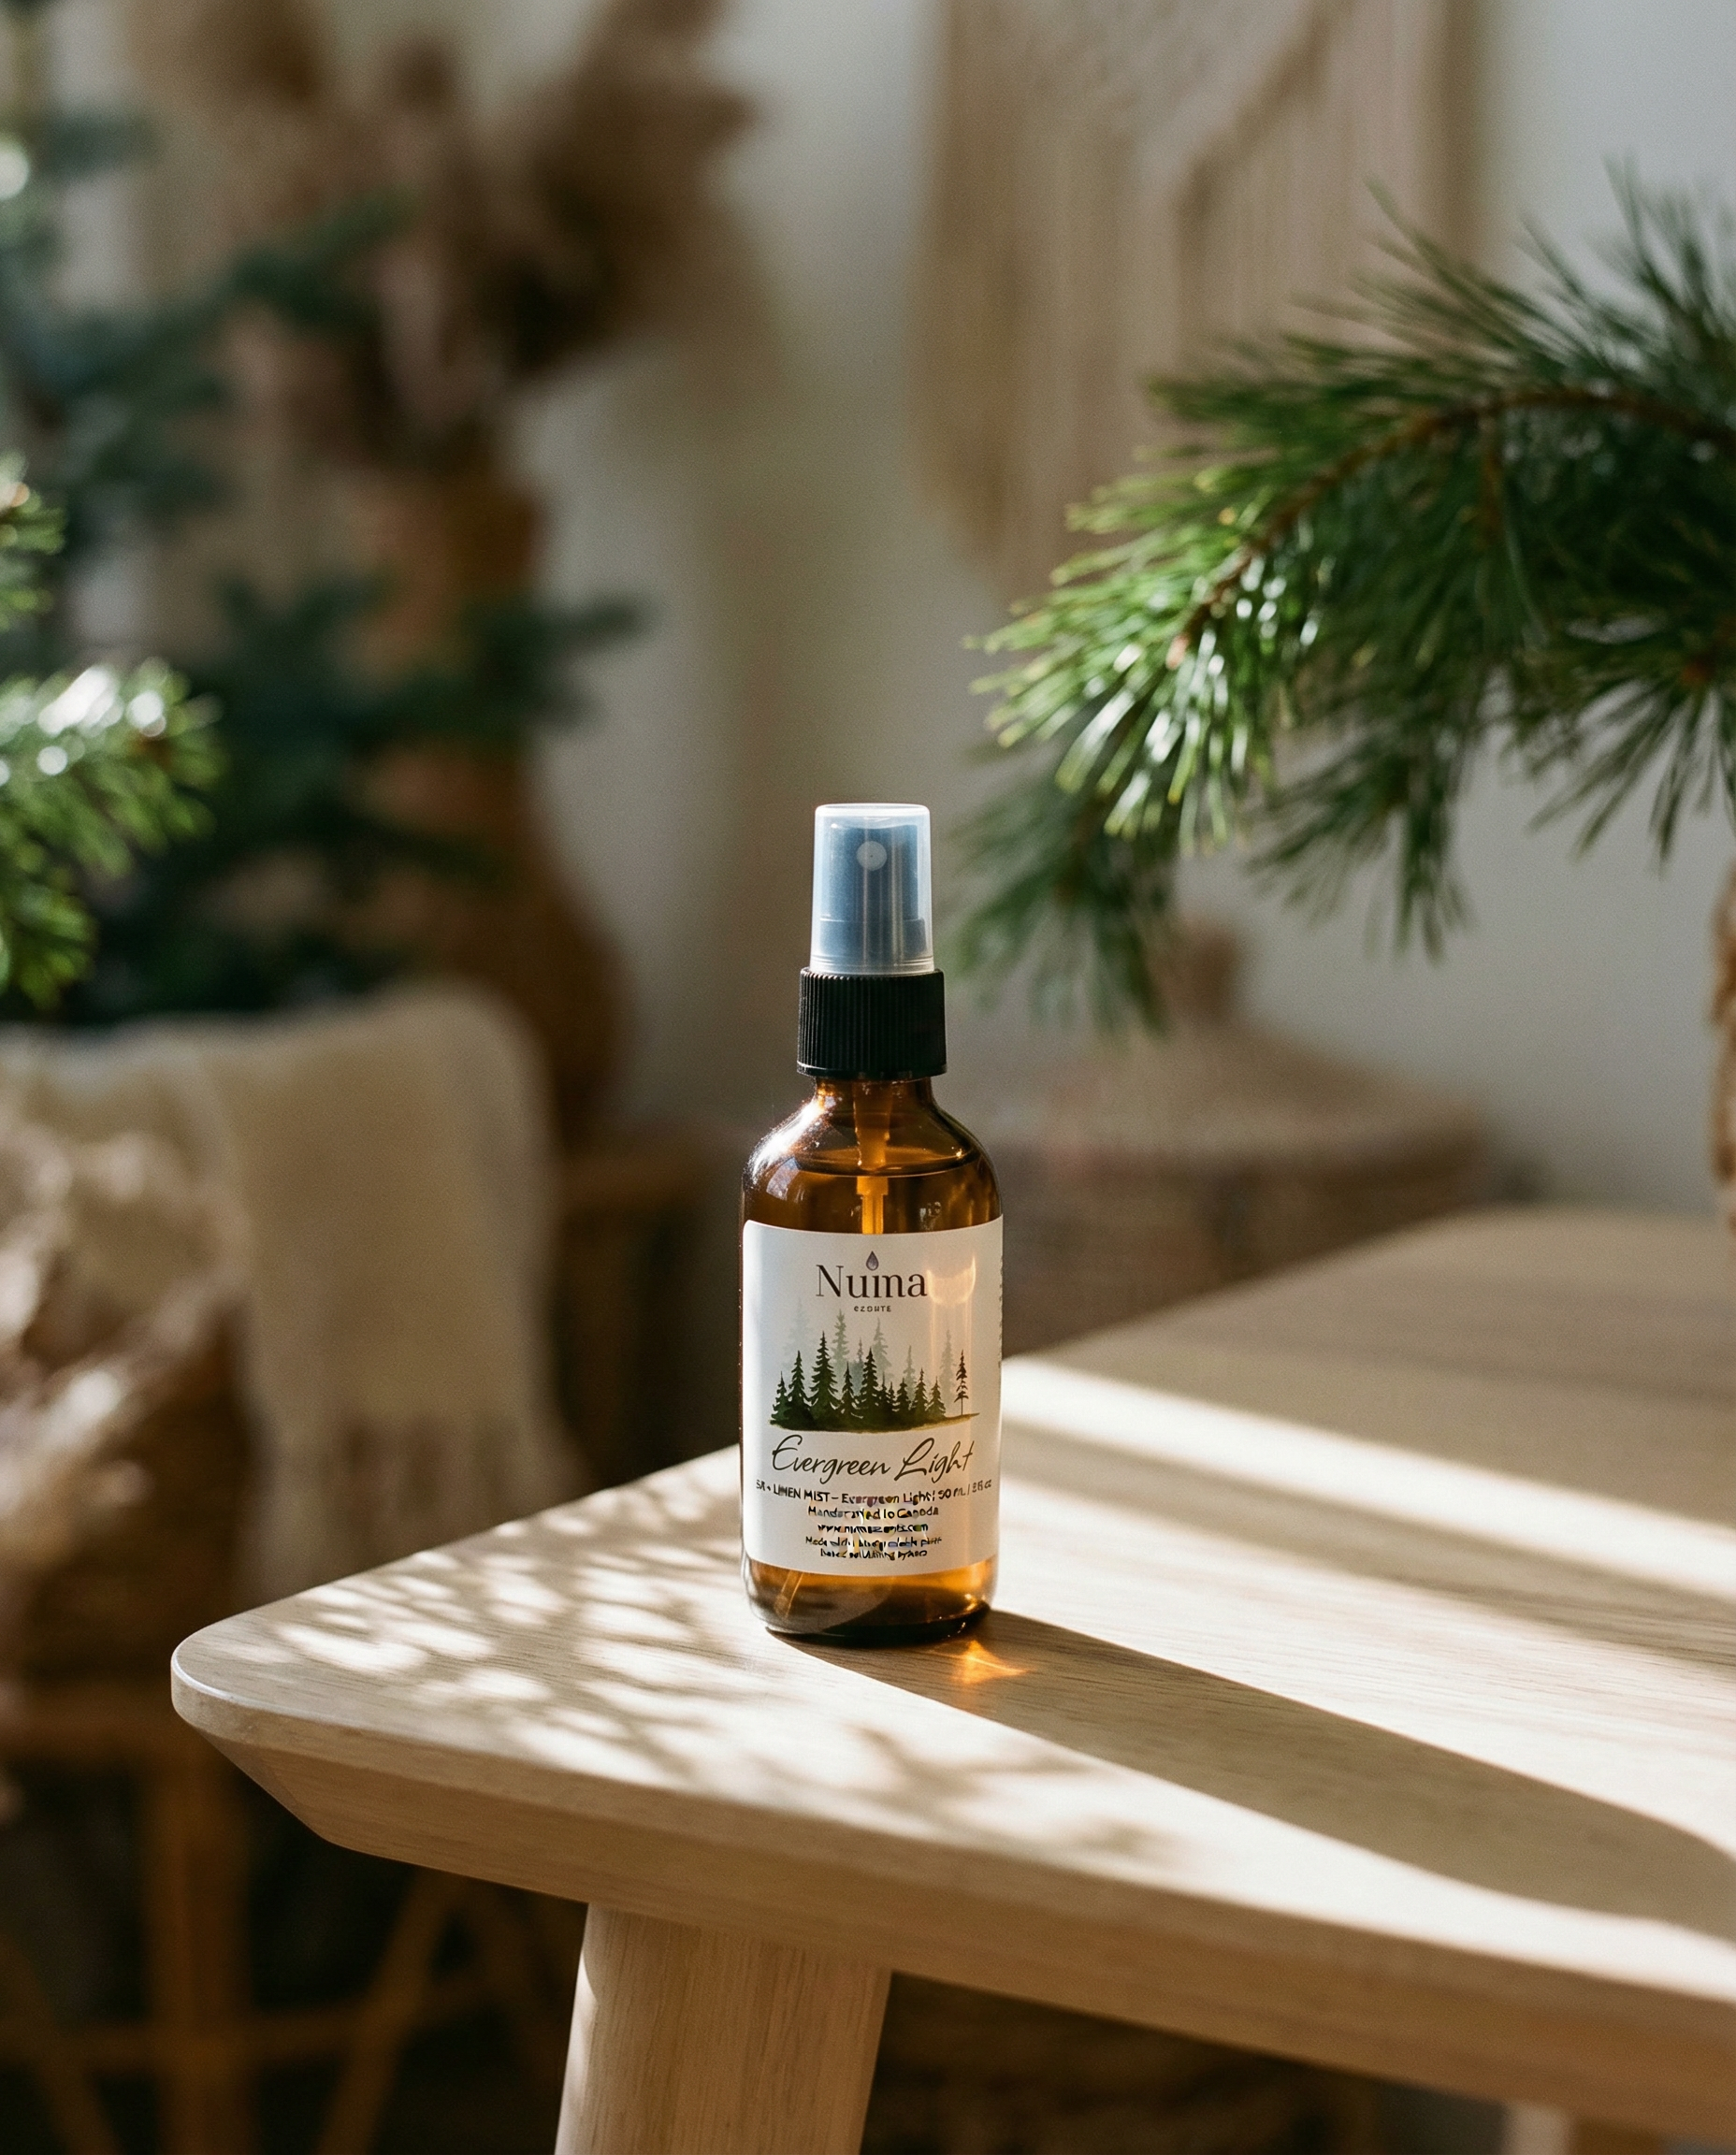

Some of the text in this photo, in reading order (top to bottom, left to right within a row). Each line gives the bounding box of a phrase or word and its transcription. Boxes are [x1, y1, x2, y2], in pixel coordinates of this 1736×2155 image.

[772, 1434, 975, 1484] Evergreen Light
[803, 1489, 831, 1502] MIST
